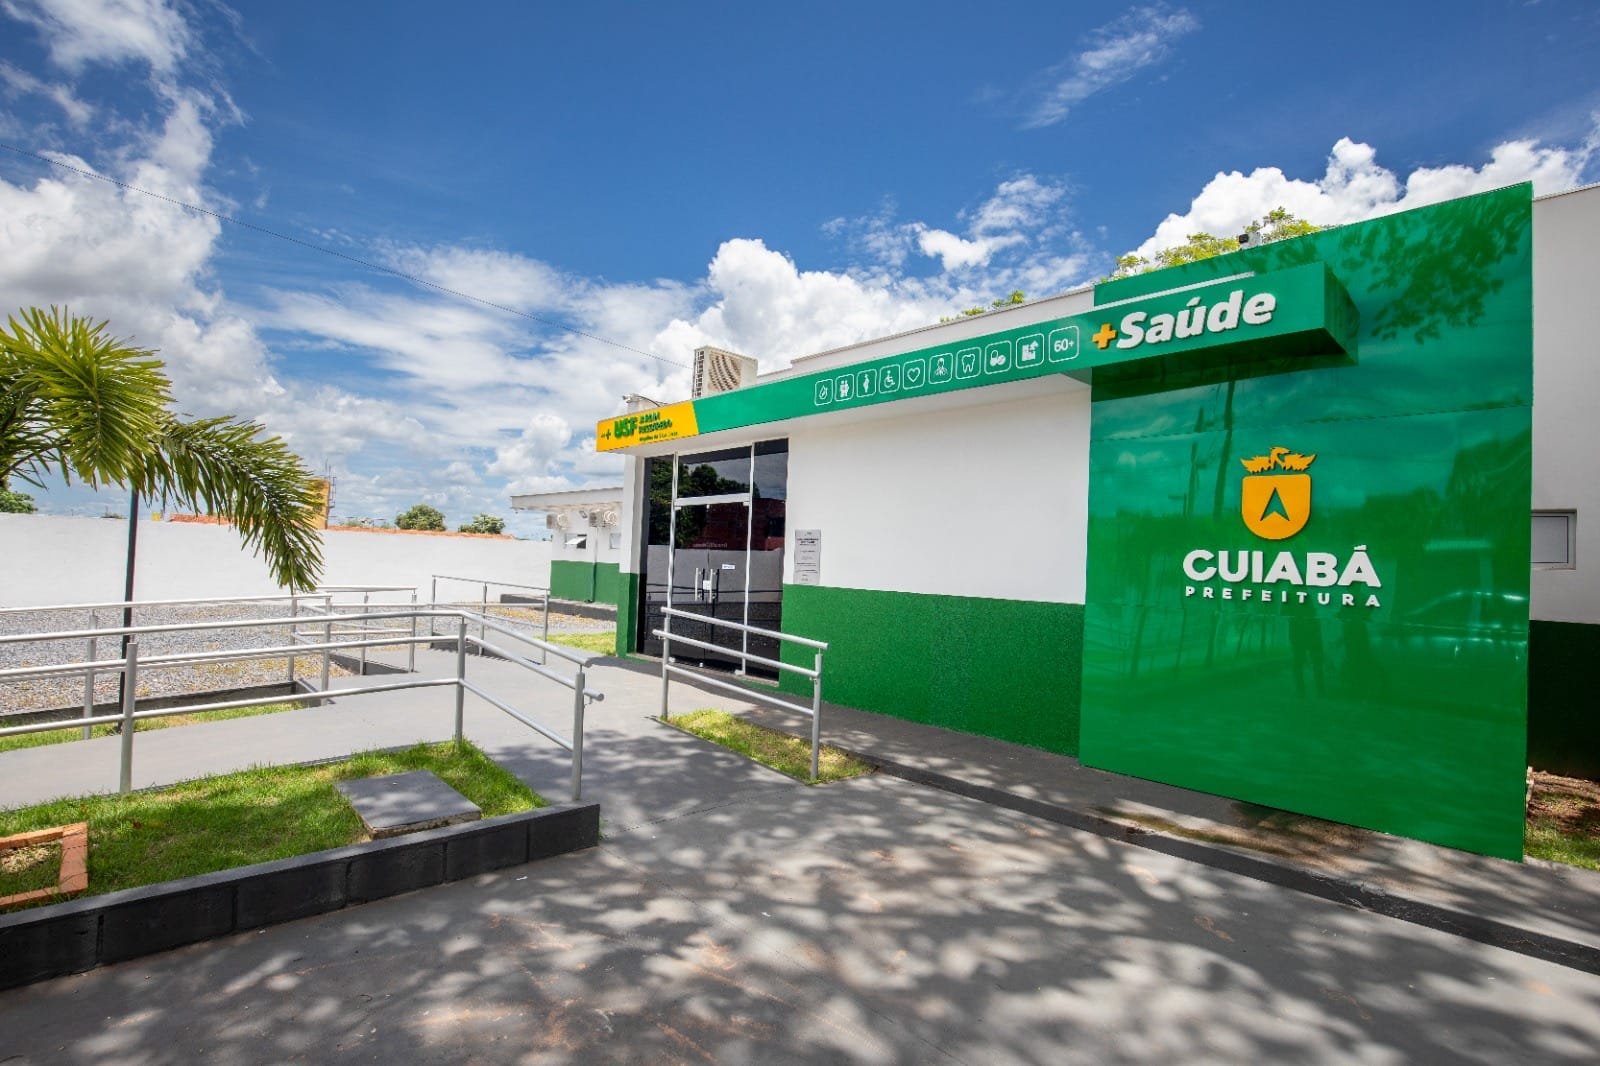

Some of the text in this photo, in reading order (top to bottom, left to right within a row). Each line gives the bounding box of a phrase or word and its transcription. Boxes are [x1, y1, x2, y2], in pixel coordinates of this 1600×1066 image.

[1054, 338, 1075, 352] 60+
[614, 417, 638, 439] USF
[1182, 545, 1382, 587] CUIABÁ
[1185, 586, 1381, 608] PREFEITURA
